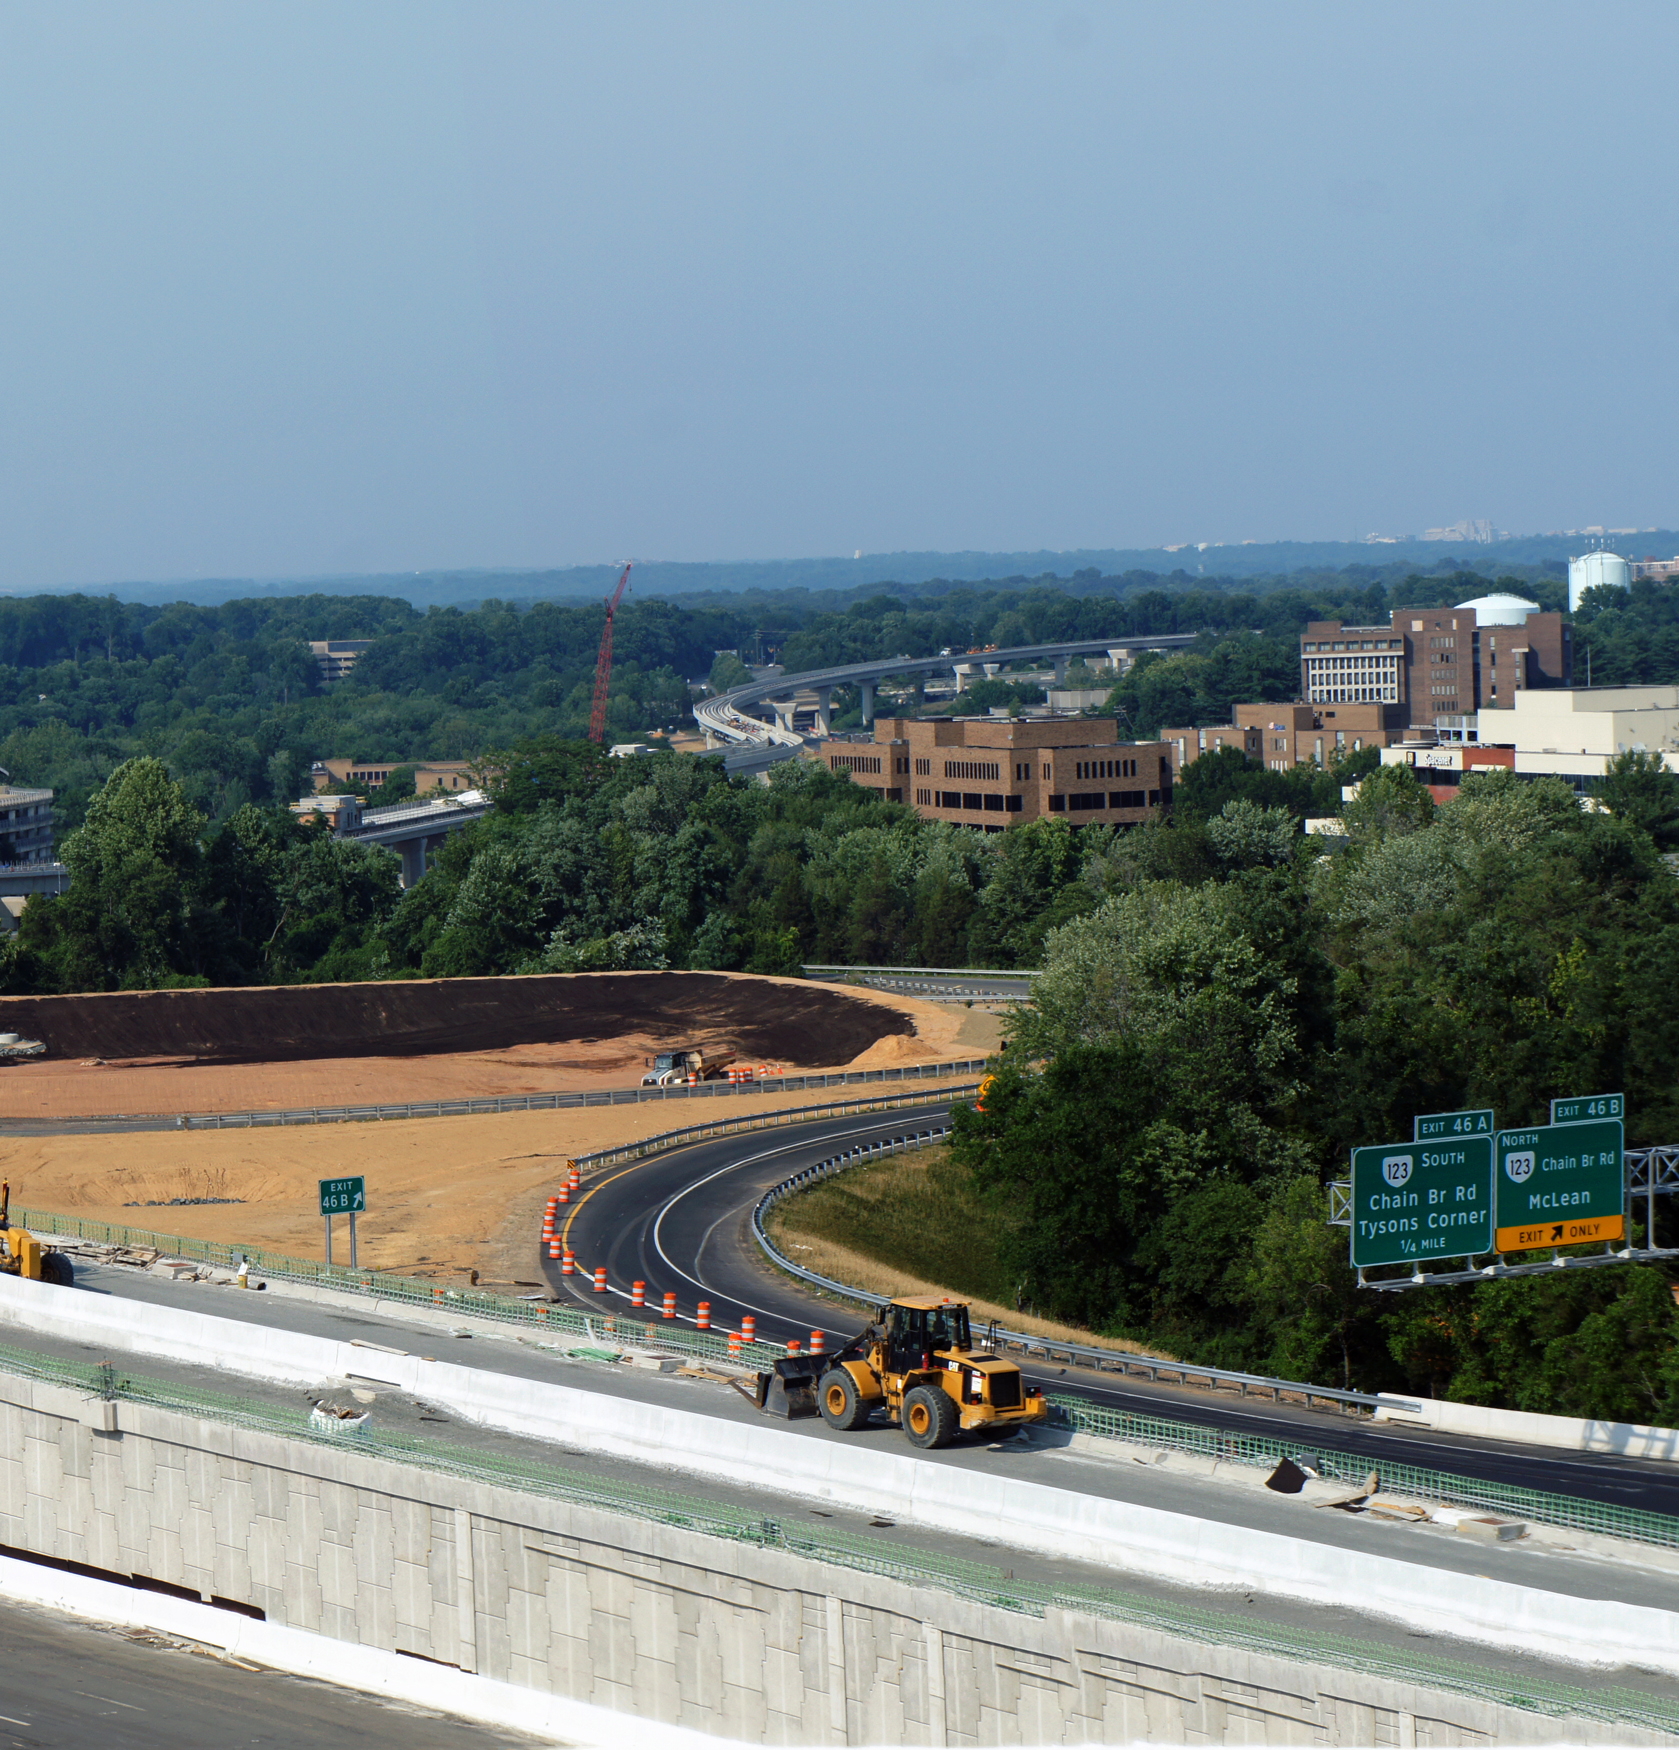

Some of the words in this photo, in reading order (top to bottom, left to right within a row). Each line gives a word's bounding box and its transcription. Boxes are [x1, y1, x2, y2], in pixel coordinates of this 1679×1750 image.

[1558, 1106, 1580, 1116] EXIT
[1588, 1100, 1606, 1116] 46
[1610, 1100, 1619, 1114] B
[1422, 1122, 1445, 1134] EXIT
[1453, 1117, 1472, 1132] 46
[1477, 1116, 1488, 1131] A
[1502, 1134, 1538, 1147] NORTH
[1388, 1162, 1408, 1180] 123
[1422, 1152, 1465, 1167] SOUTH
[1510, 1158, 1530, 1176] 123
[1542, 1156, 1576, 1172] Chain
[1581, 1154, 1594, 1167] Br
[1600, 1151, 1614, 1166] Rd
[330, 1182, 353, 1192] EXIT
[322, 1195, 338, 1208] 46
[340, 1194, 348, 1206] B
[1370, 1191, 1418, 1210] Chain
[1428, 1189, 1446, 1204] Br
[1456, 1184, 1476, 1201] Rd
[1529, 1191, 1591, 1210] McLean
[1359, 1218, 1418, 1240] Tysons
[1428, 1210, 1486, 1228] Corner
[1520, 1230, 1543, 1243] EXIT
[1570, 1224, 1600, 1238] ONLY
[1421, 1238, 1446, 1250] MILE
[948, 1360, 960, 1372] CAT
